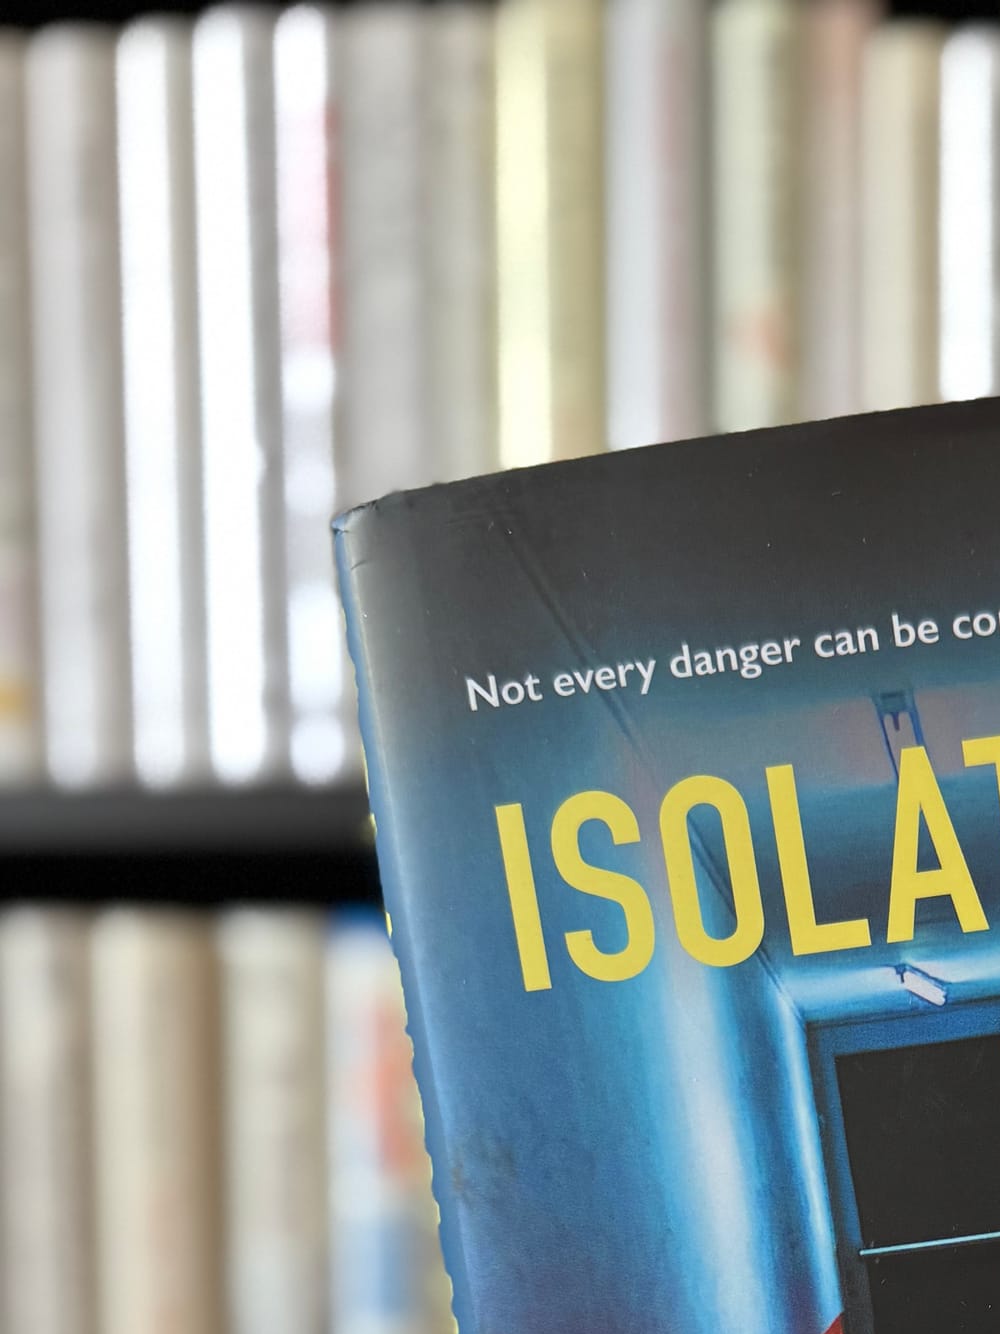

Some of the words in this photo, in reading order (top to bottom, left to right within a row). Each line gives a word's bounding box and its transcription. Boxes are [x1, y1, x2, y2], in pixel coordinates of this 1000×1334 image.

[466, 673, 543, 711] Not
[553, 658, 657, 695] every
[669, 636, 801, 679] danger
[813, 625, 881, 660] can
[890, 611, 941, 650] be
